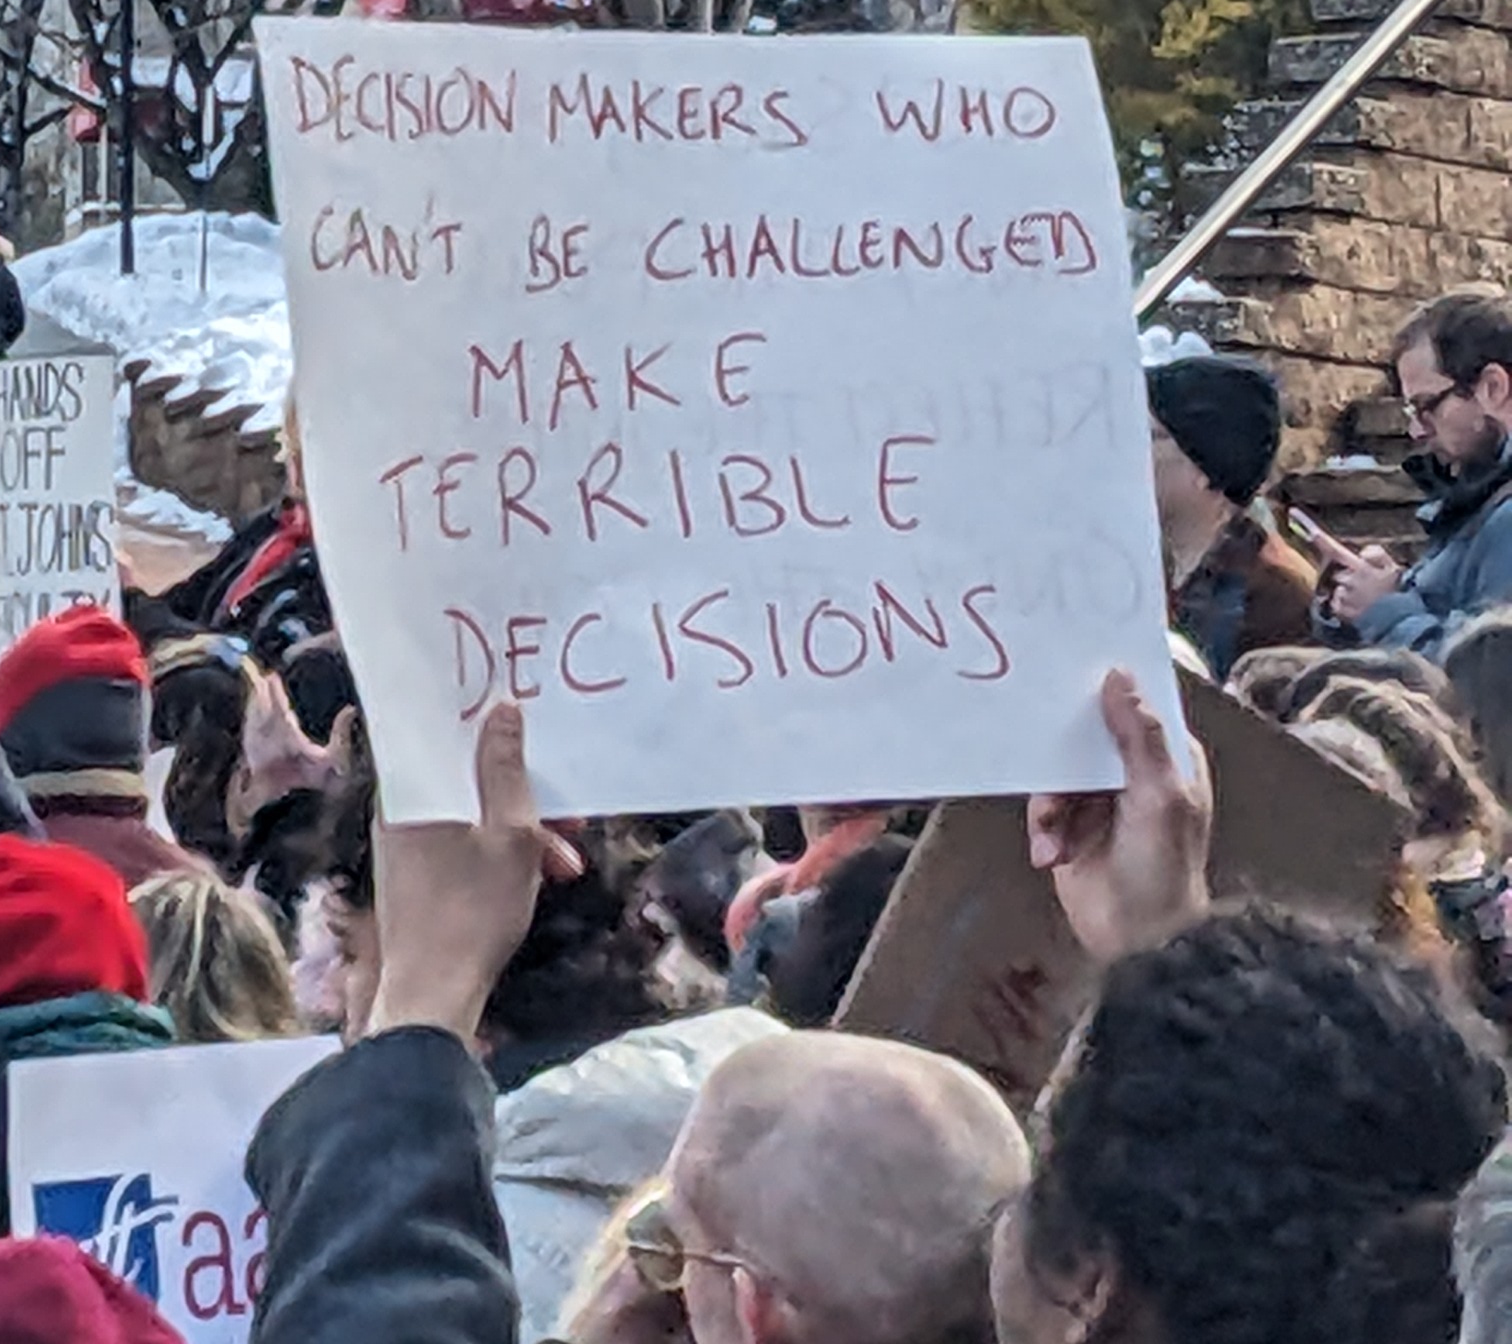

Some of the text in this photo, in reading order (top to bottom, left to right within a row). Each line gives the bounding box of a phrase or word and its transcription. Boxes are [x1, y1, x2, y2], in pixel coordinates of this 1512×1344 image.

[290, 54, 1056, 146] DECISION MAKERS WHO
[310, 192, 1098, 294] CAN'T BE CHALLENGED
[469, 331, 766, 432] MAKE
[0, 425, 67, 491] OFF
[378, 435, 937, 552] TERRIBLE
[443, 581, 1010, 722] DECISIONS
